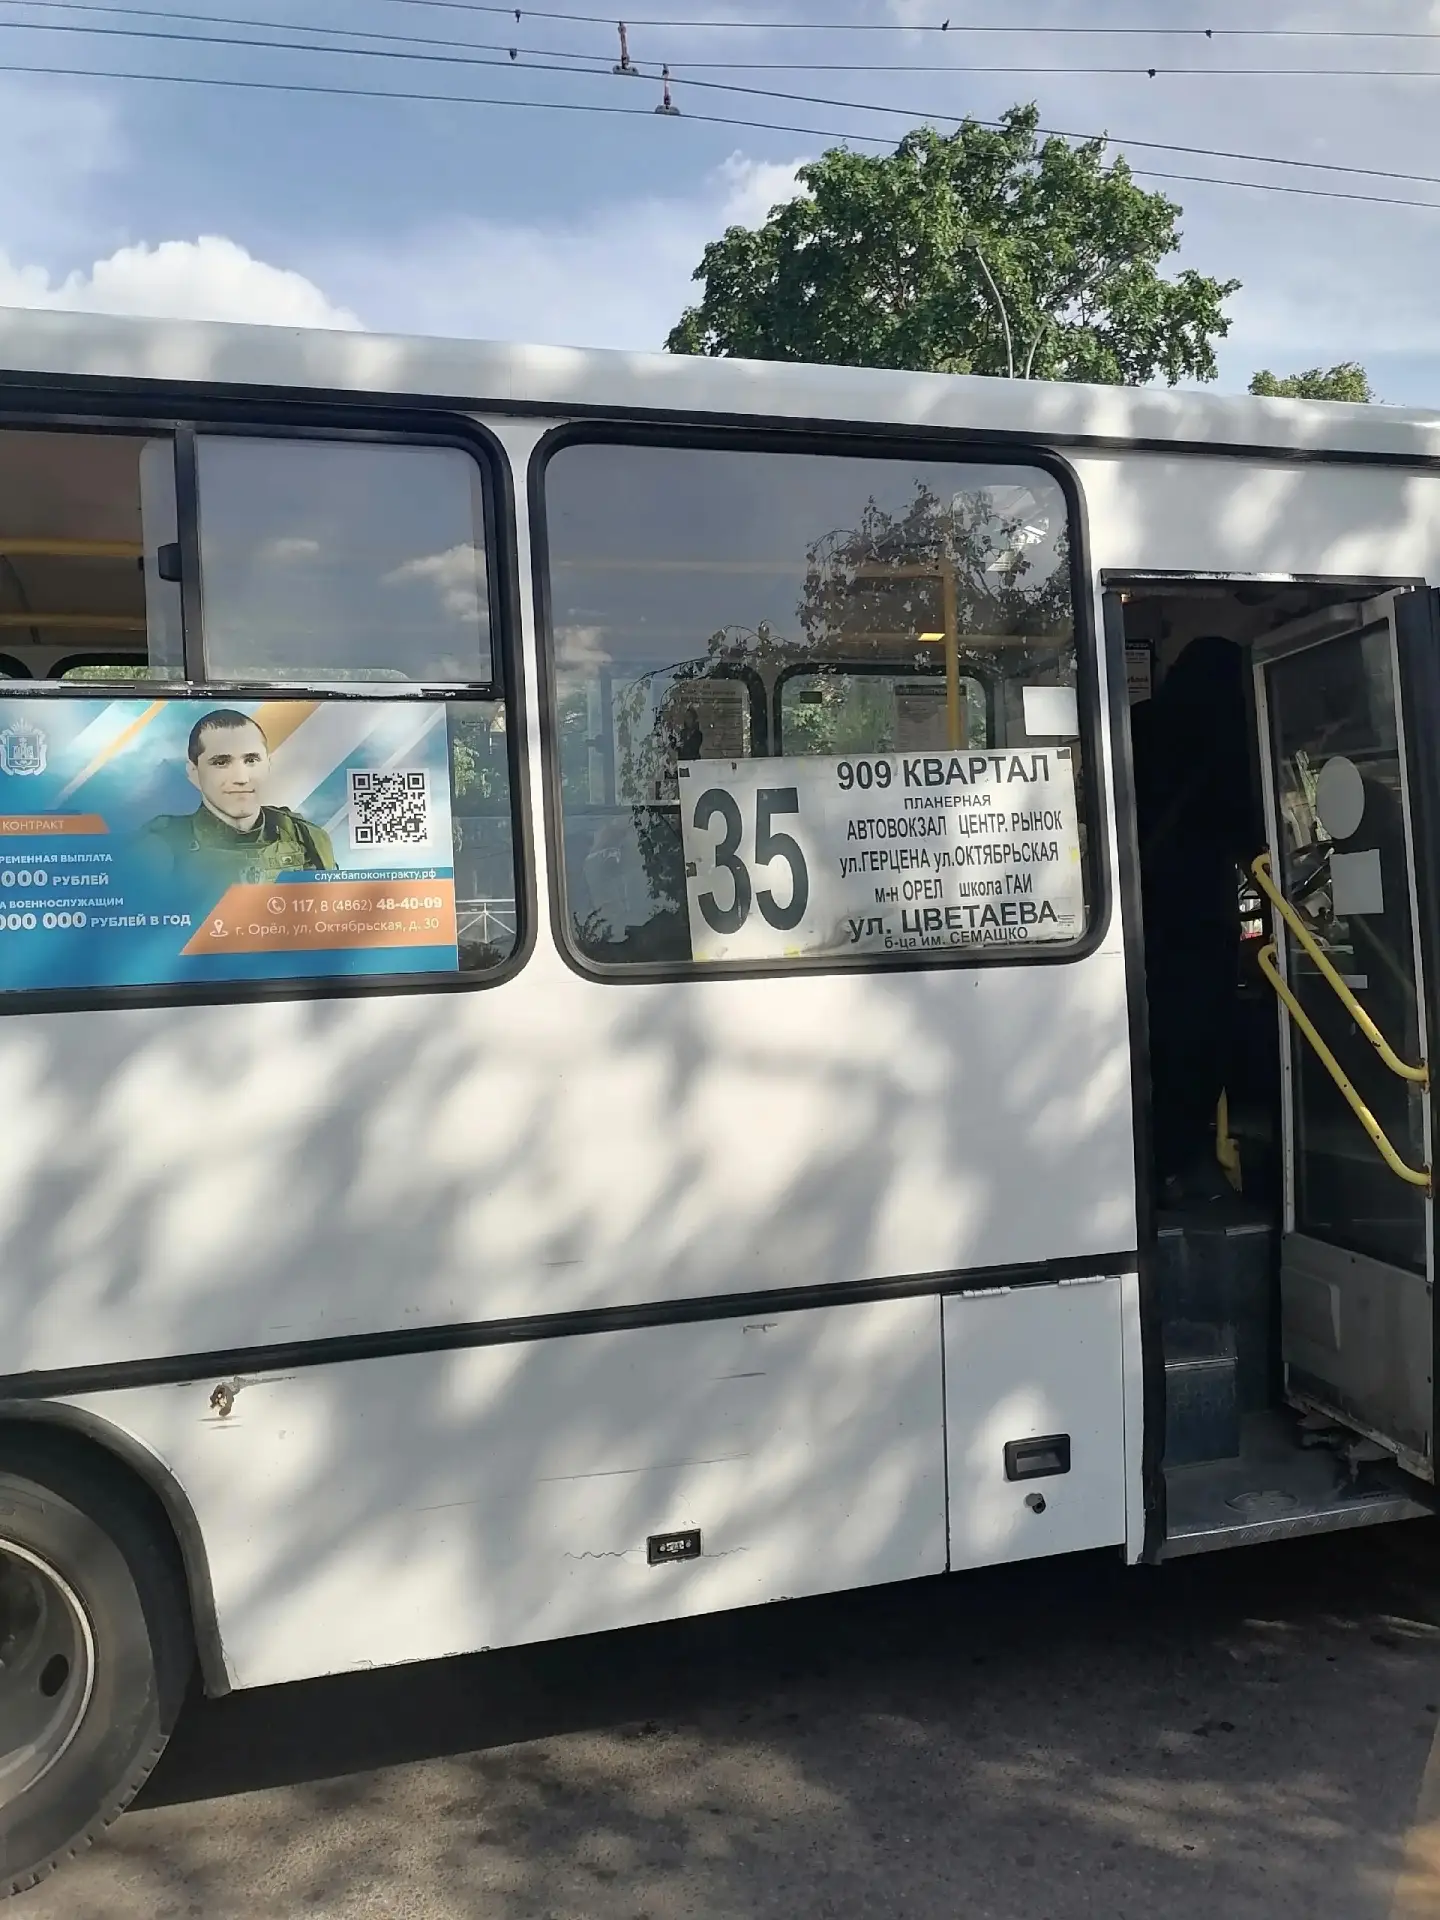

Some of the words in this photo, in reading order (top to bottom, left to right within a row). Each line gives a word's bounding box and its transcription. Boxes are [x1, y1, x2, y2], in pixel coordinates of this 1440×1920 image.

[837, 760, 891, 790] 909
[902, 754, 1049, 787] КВАРТАЛ
[904, 794, 991, 810] ПЛАНЕРНАЯ
[2, 820, 65, 831] КОНТРАКТ
[847, 815, 947, 841] АВТОВОКЗАЛ
[958, 812, 1008, 838] ЦЕНТР.
[1011, 810, 1063, 832] РЫНОК
[60, 853, 113, 863] ВЫПЛАТА
[692, 786, 809, 935] 35
[839, 848, 931, 878] ул.ГЕРЦЕНА
[934, 841, 1059, 873] ул.ОКТЯБРЬСКАЯ
[1, 869, 48, 888] 000
[52, 872, 109, 886] РУБЛЕЙ
[314, 868, 437, 882] службапоконтракту.рф
[874, 886, 899, 903] м-н
[902, 878, 943, 901] ОРЕЛ
[959, 880, 1002, 898] школа
[1005, 873, 1032, 895] ГАИ
[9, 897, 124, 909] ВОЕННОСЛУЖАЩИМ
[292, 900, 318, 914] 117,
[320, 901, 328, 912] 8
[332, 898, 373, 913] (4862)
[376, 896, 443, 910] 48-40-09
[42, 911, 87, 929] 000
[90, 913, 147, 928] РУБЛЕЙ
[149, 915, 159, 926] В
[162, 914, 192, 927] ГОД
[235, 926, 244, 936] г.
[248, 922, 290, 938] Орёл,
[293, 924, 312, 937] ул.
[315, 919, 407, 935] Октябрьская,
[408, 920, 421, 932] д.
[423, 917, 439, 930] 30
[848, 916, 892, 943] ул.
[901, 900, 1059, 937] ЦВЕТАЕВА
[884, 935, 917, 950] б-ца
[921, 936, 946, 947] им.
[950, 926, 1029, 944] СЕМАШКО
